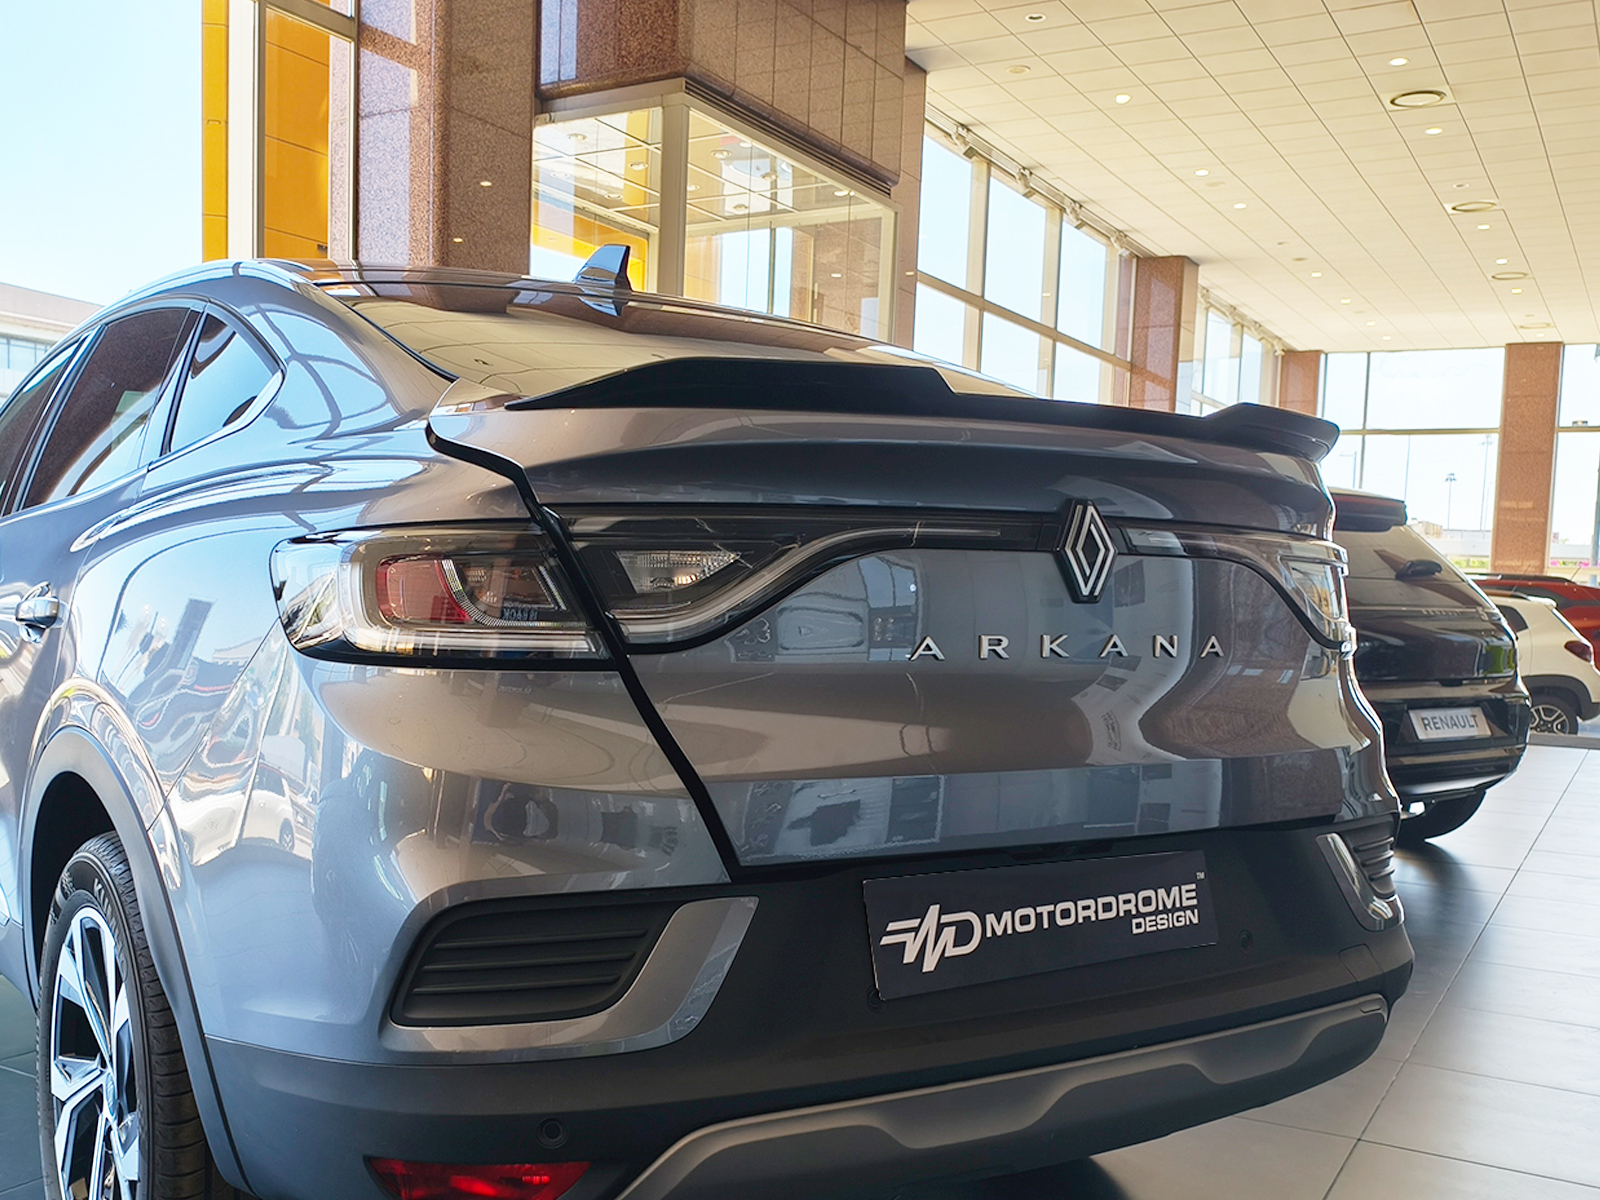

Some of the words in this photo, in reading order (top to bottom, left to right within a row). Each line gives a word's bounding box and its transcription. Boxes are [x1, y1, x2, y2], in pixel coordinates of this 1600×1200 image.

[910, 634, 1225, 661] ARKANA
[1421, 714, 1479, 731] RENAULT
[985, 883, 1198, 938] MOTORDROME
[1131, 908, 1199, 934] DESIGN
